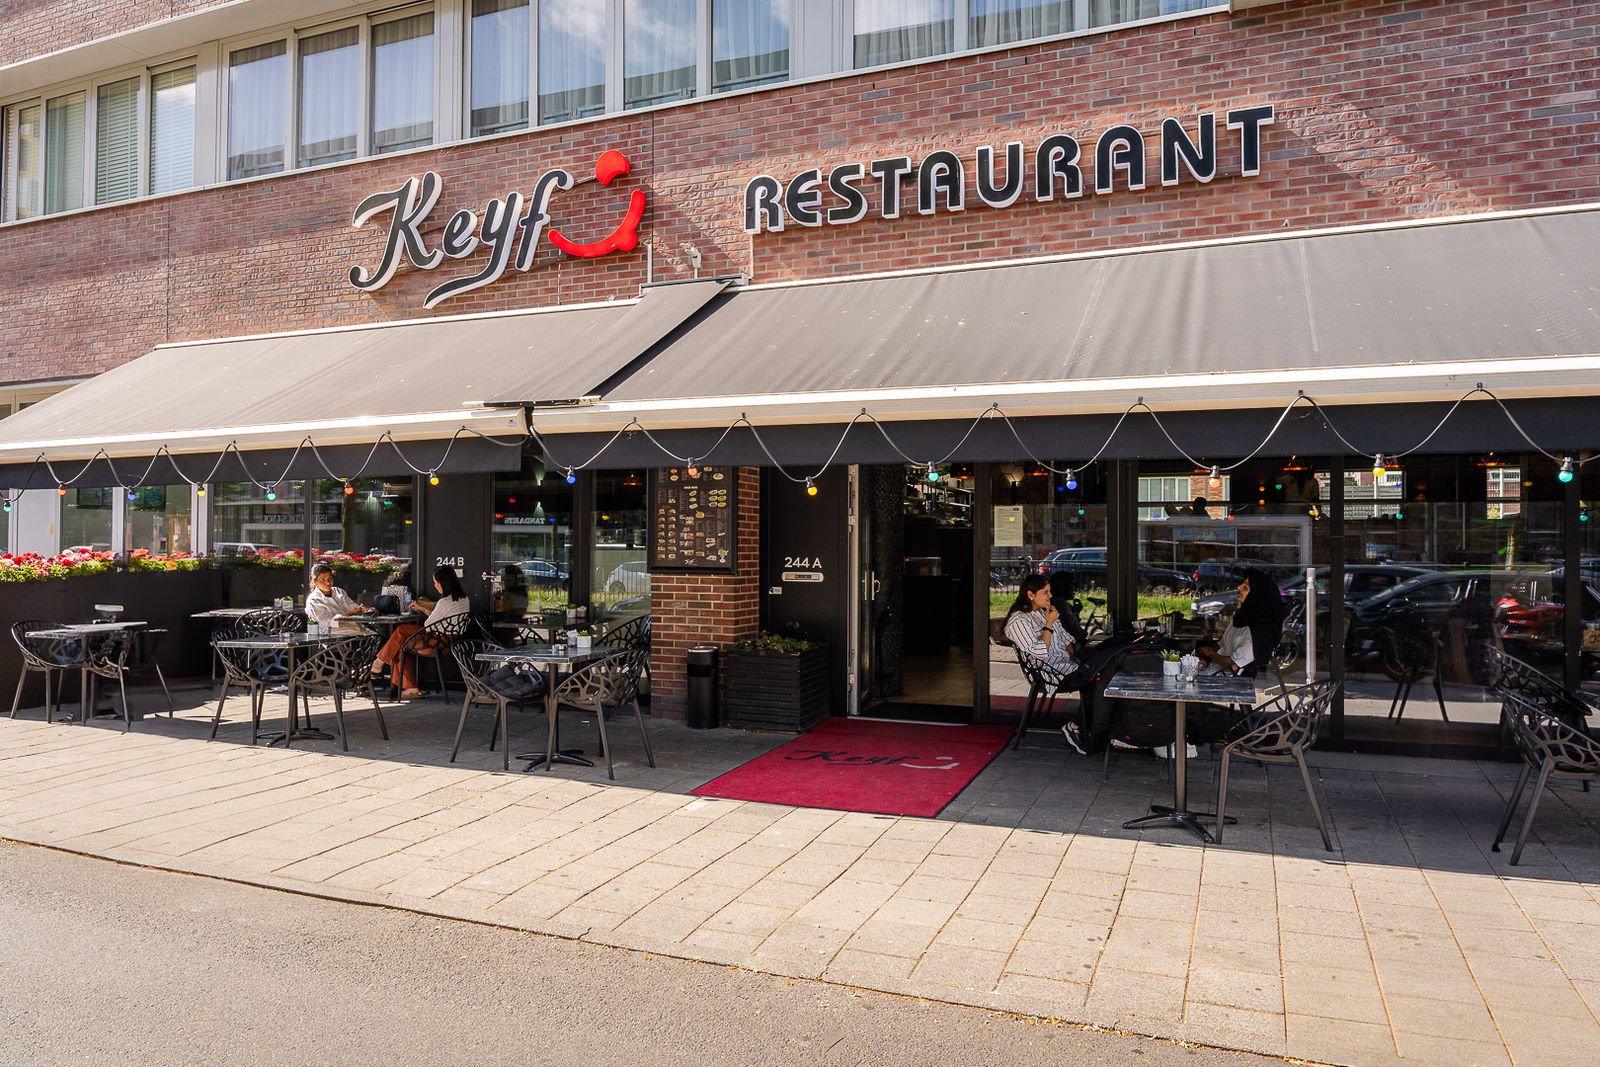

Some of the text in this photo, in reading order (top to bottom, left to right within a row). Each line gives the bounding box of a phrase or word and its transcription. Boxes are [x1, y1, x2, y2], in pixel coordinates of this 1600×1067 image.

[744, 104, 1275, 234] RESTAURANT
[349, 169, 575, 310] Keyf
[436, 556, 465, 567] 244 B
[784, 556, 822, 569] 244 A
[784, 750, 920, 766] Keyf
